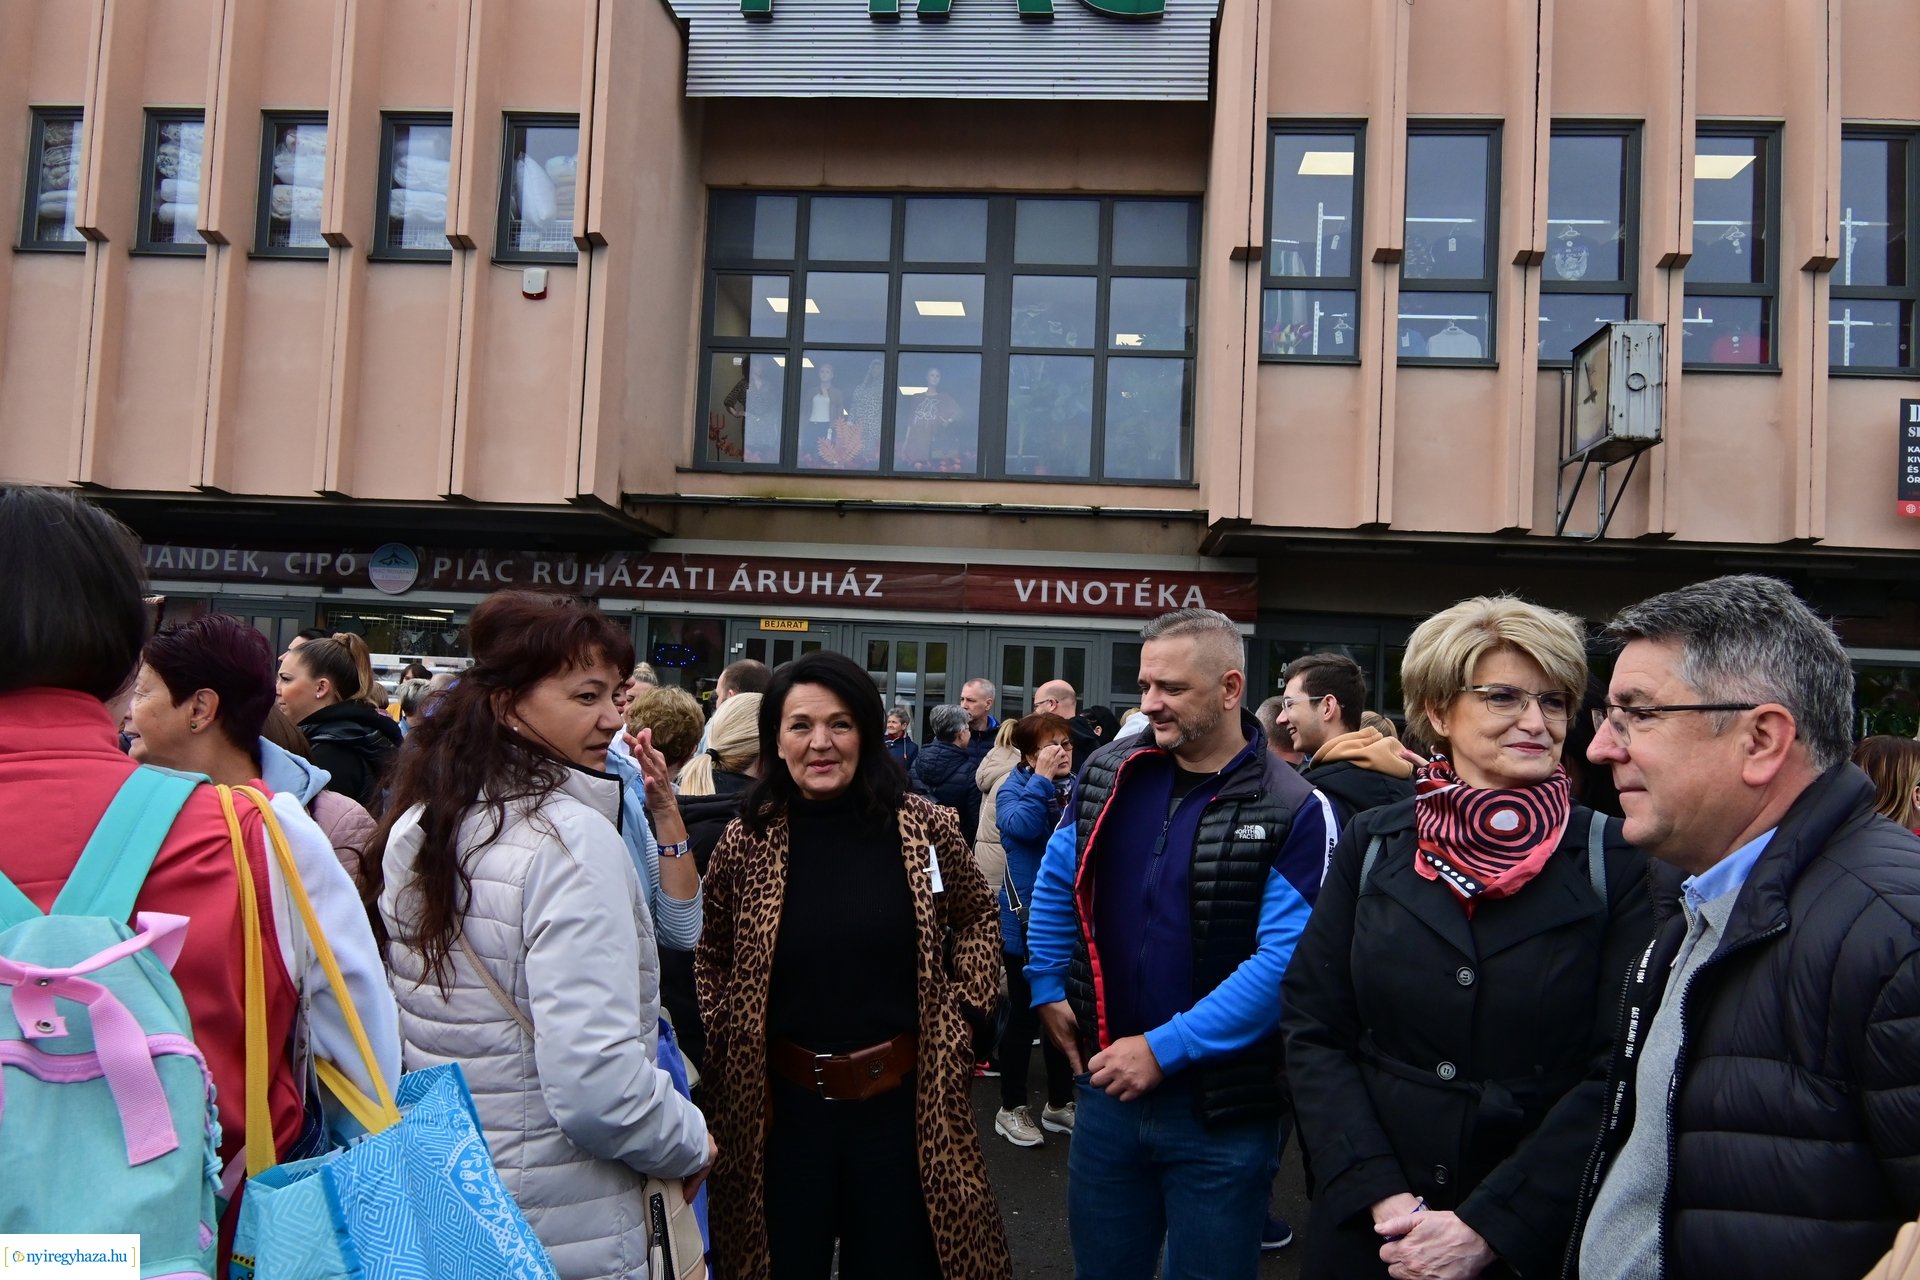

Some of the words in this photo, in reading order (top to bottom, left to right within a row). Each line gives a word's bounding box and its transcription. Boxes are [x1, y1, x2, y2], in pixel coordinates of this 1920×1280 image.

[1907, 465, 1919, 473] ÉS
[143, 541, 269, 578] JÁNDÉK,
[284, 547, 356, 576] CIPŐ
[433, 557, 514, 582] PIAC
[532, 560, 715, 591] RUHÁZATI
[728, 562, 884, 598] ÁRUHÁZ
[1013, 577, 1206, 609] VINOTÉKA
[1631, 1006, 1640, 1019] GAS
[1627, 1019, 1638, 1042] MILANO
[1625, 1043, 1634, 1058] 1984
[1612, 1091, 1623, 1115] MILANO
